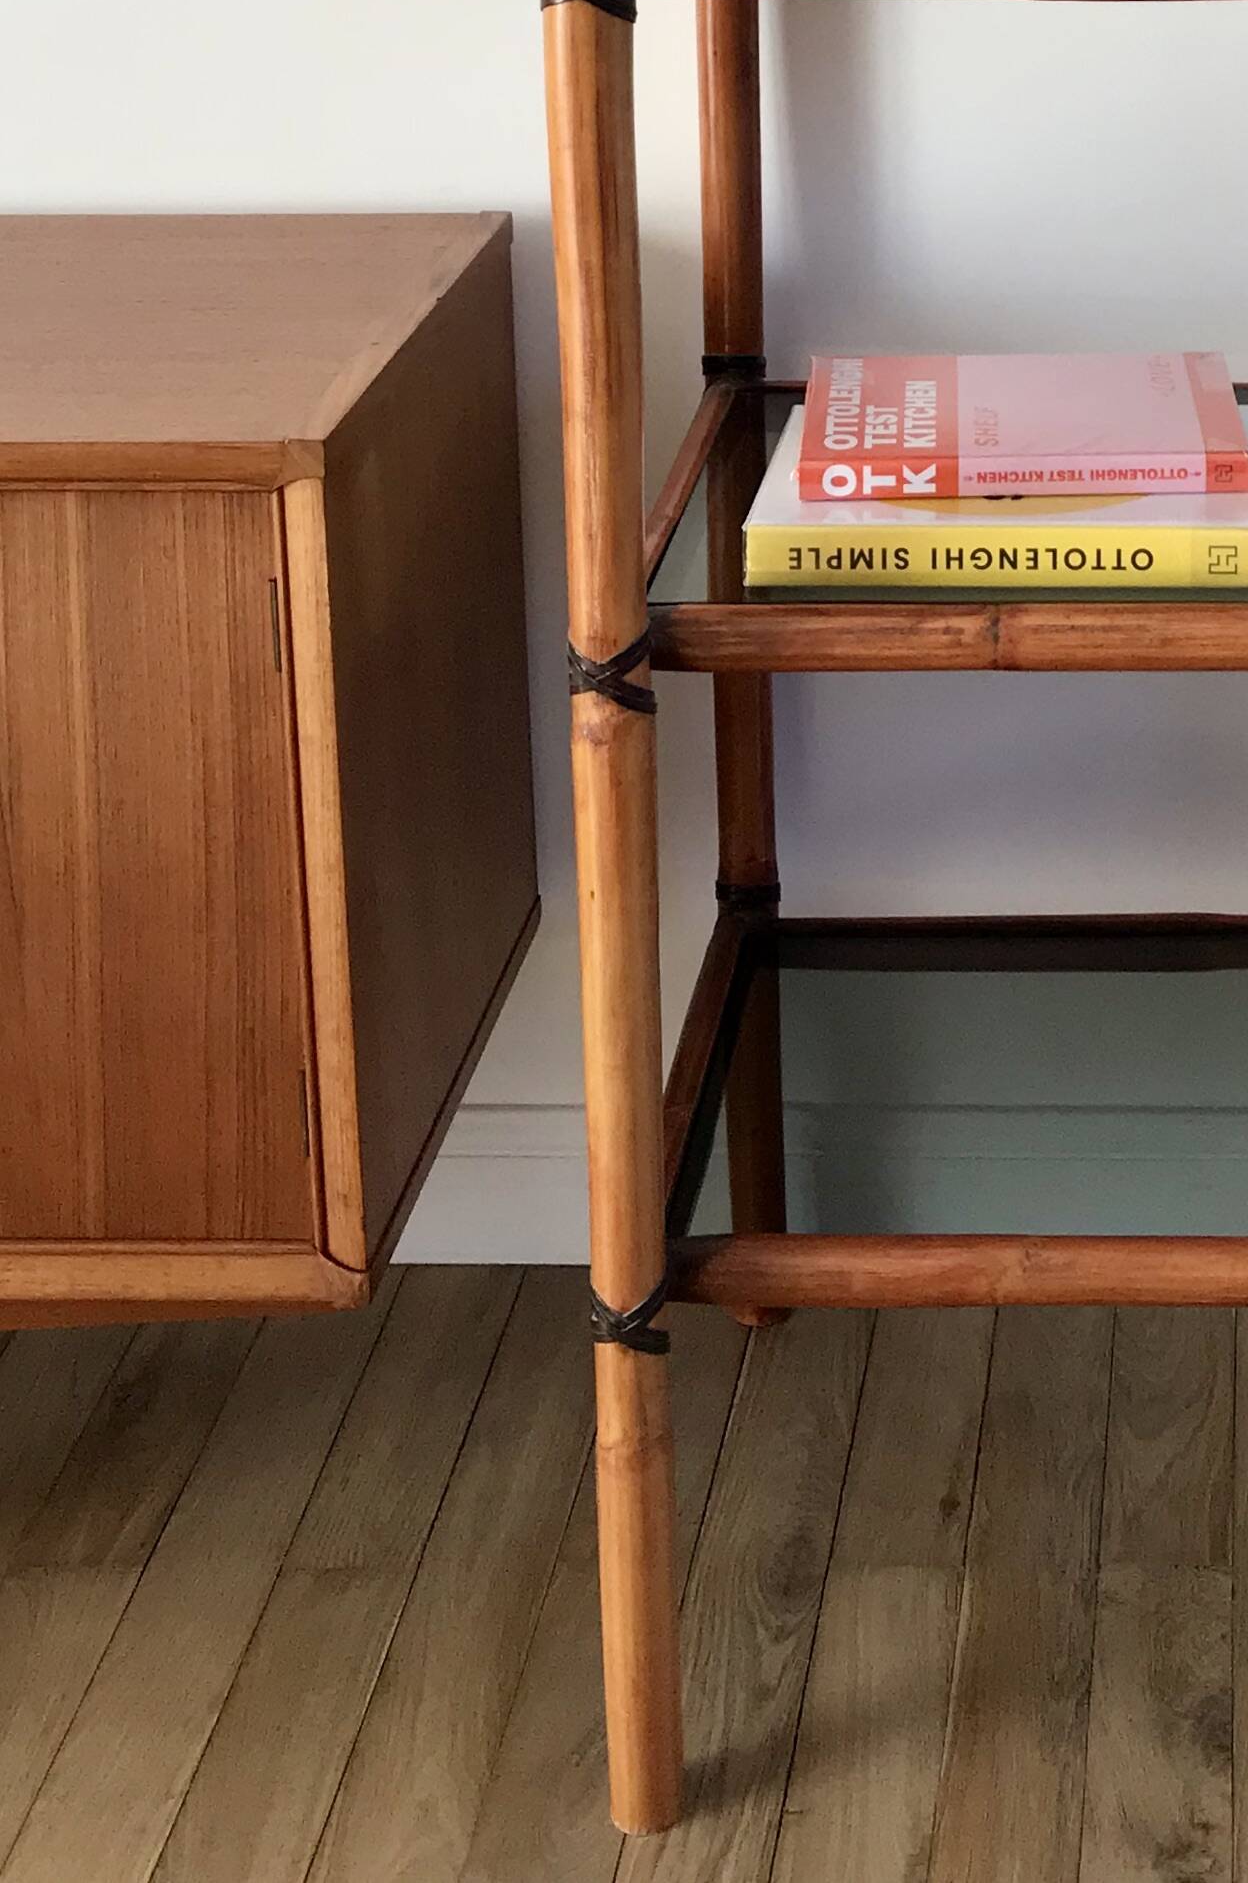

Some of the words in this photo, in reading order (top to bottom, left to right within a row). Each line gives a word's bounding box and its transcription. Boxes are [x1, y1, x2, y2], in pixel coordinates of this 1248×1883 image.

[904, 381, 936, 447] KITCHEN
[864, 405, 898, 449] TEST
[976, 470, 1045, 484] KITCHEN
[1049, 470, 1084, 482] TEST
[1090, 468, 1189, 482] OTTOLENGHI
[788, 547, 910, 571] SIMPLE
[931, 547, 1154, 571] OTTOLENGHI
